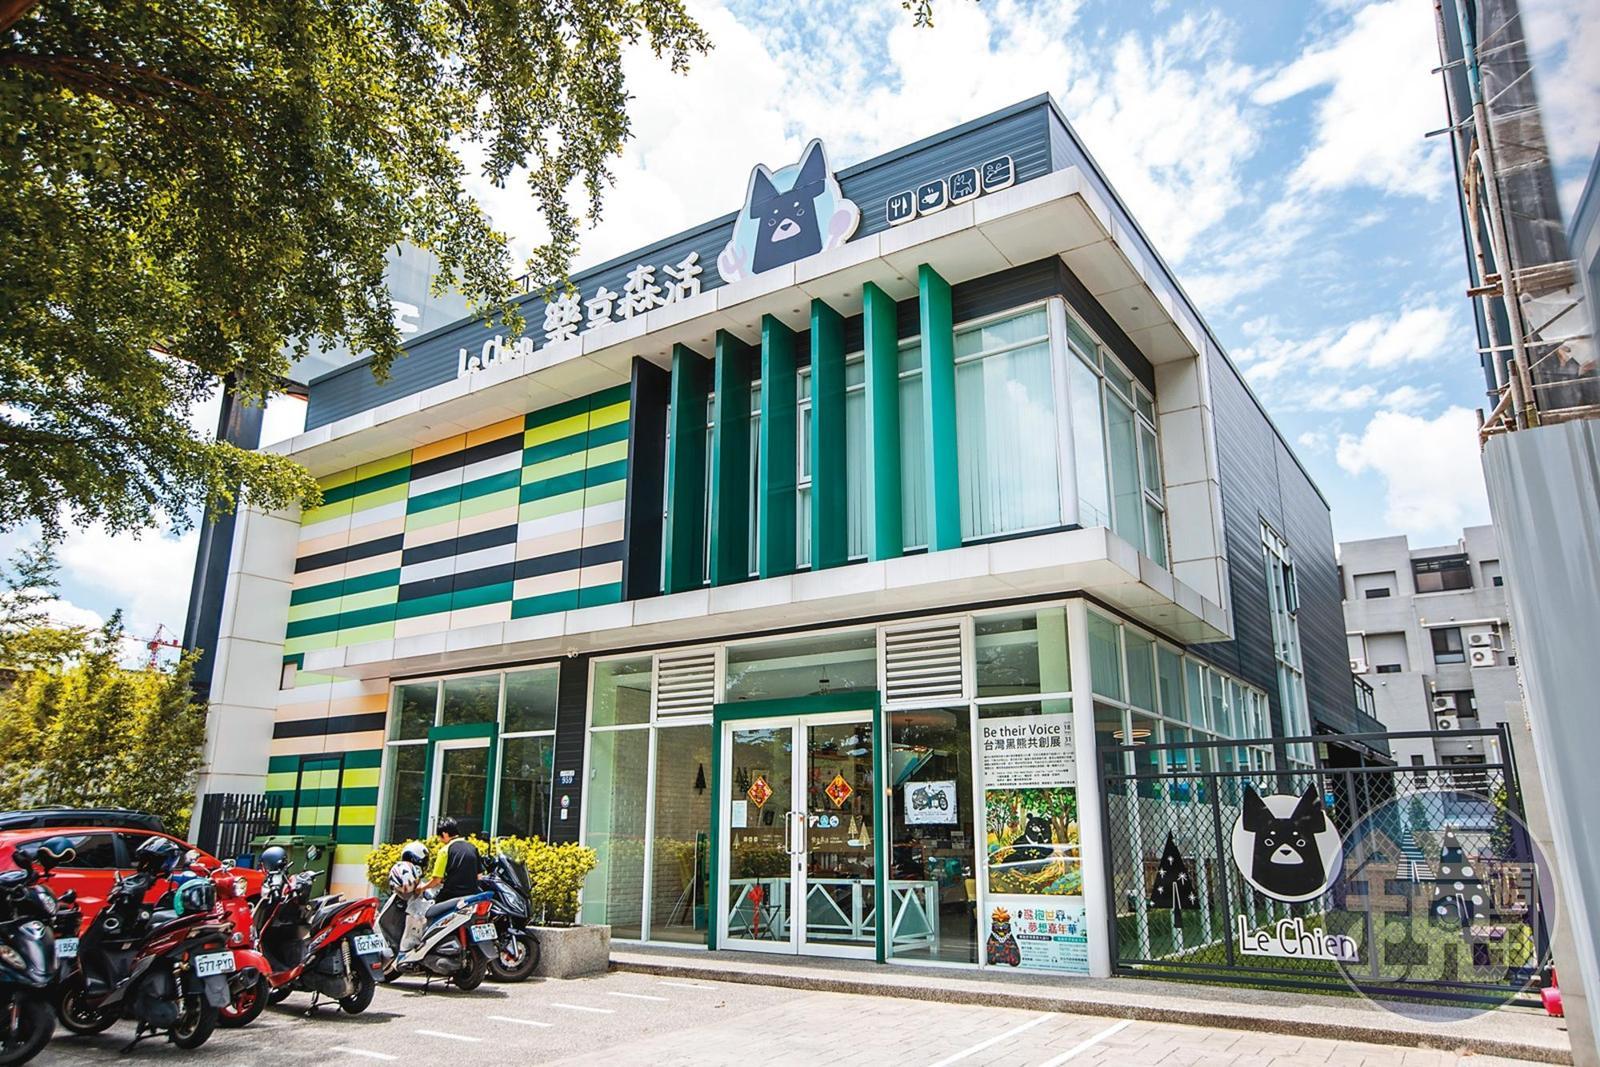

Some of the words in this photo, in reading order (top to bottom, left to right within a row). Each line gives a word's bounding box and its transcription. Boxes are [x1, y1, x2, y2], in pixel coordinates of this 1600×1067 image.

[984, 727, 997, 738] Be
[1000, 725, 1026, 737] their
[1028, 724, 1060, 735] Voice
[984, 736, 1061, 751] 台灣黑熊共創展
[1240, 916, 1270, 952] Le
[1279, 918, 1356, 958] Chien
